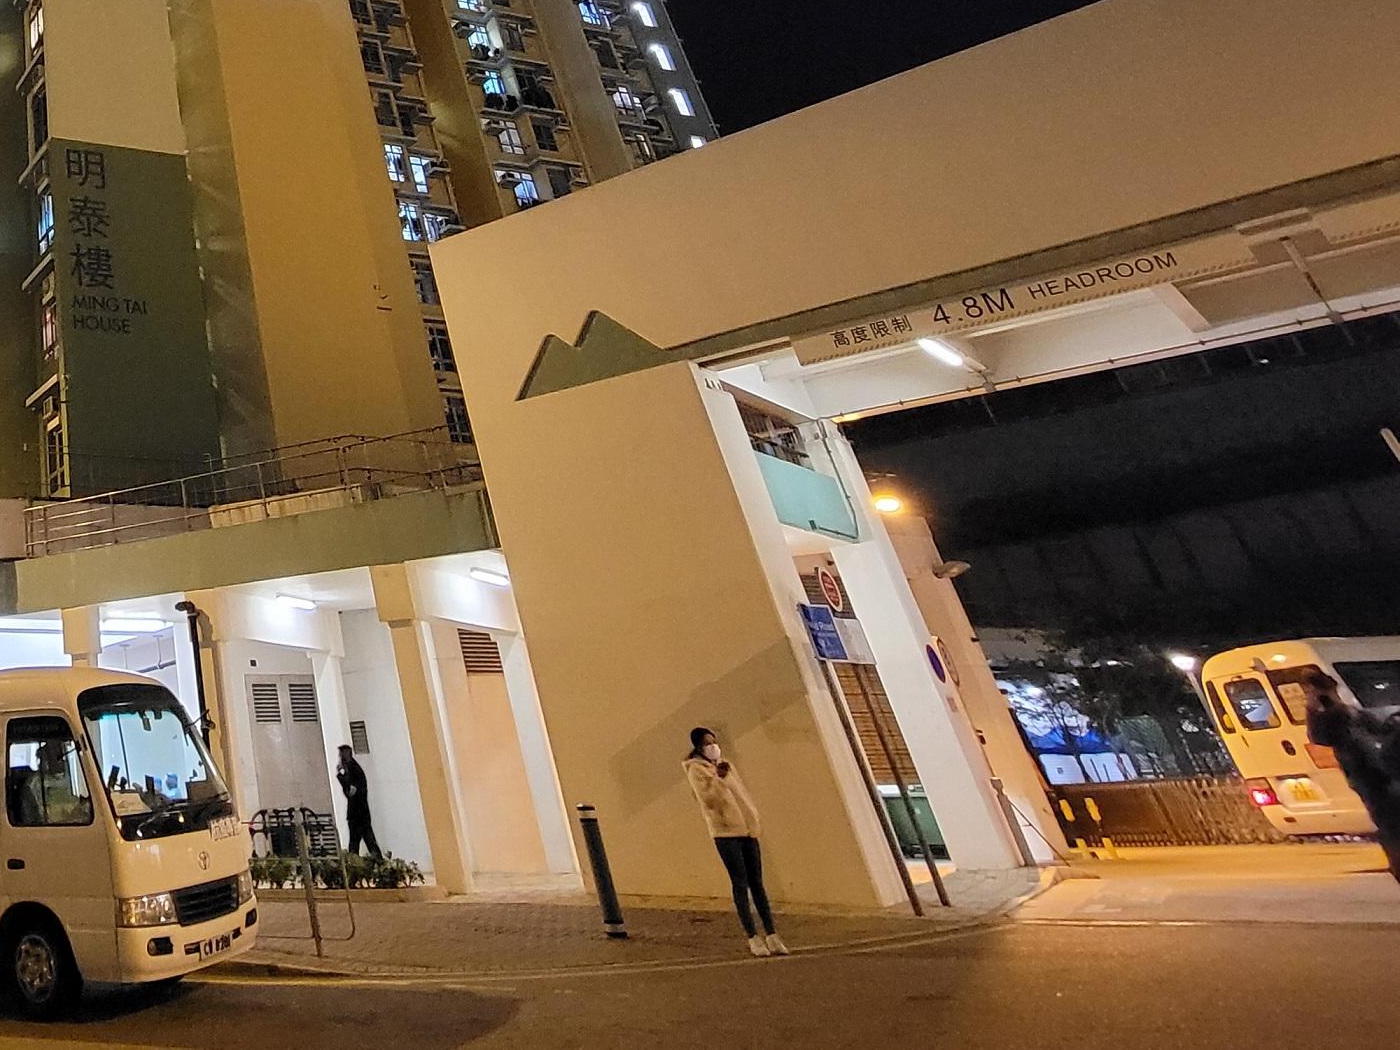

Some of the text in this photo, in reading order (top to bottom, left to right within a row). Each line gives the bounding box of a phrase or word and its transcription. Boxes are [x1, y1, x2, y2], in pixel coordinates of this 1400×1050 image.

[65, 148, 114, 289] 明泰樓
[71, 294, 148, 315] MING TAI
[72, 314, 131, 334] HOUSE
[829, 252, 1178, 348] 高度限制 4.8M HEADROOM
